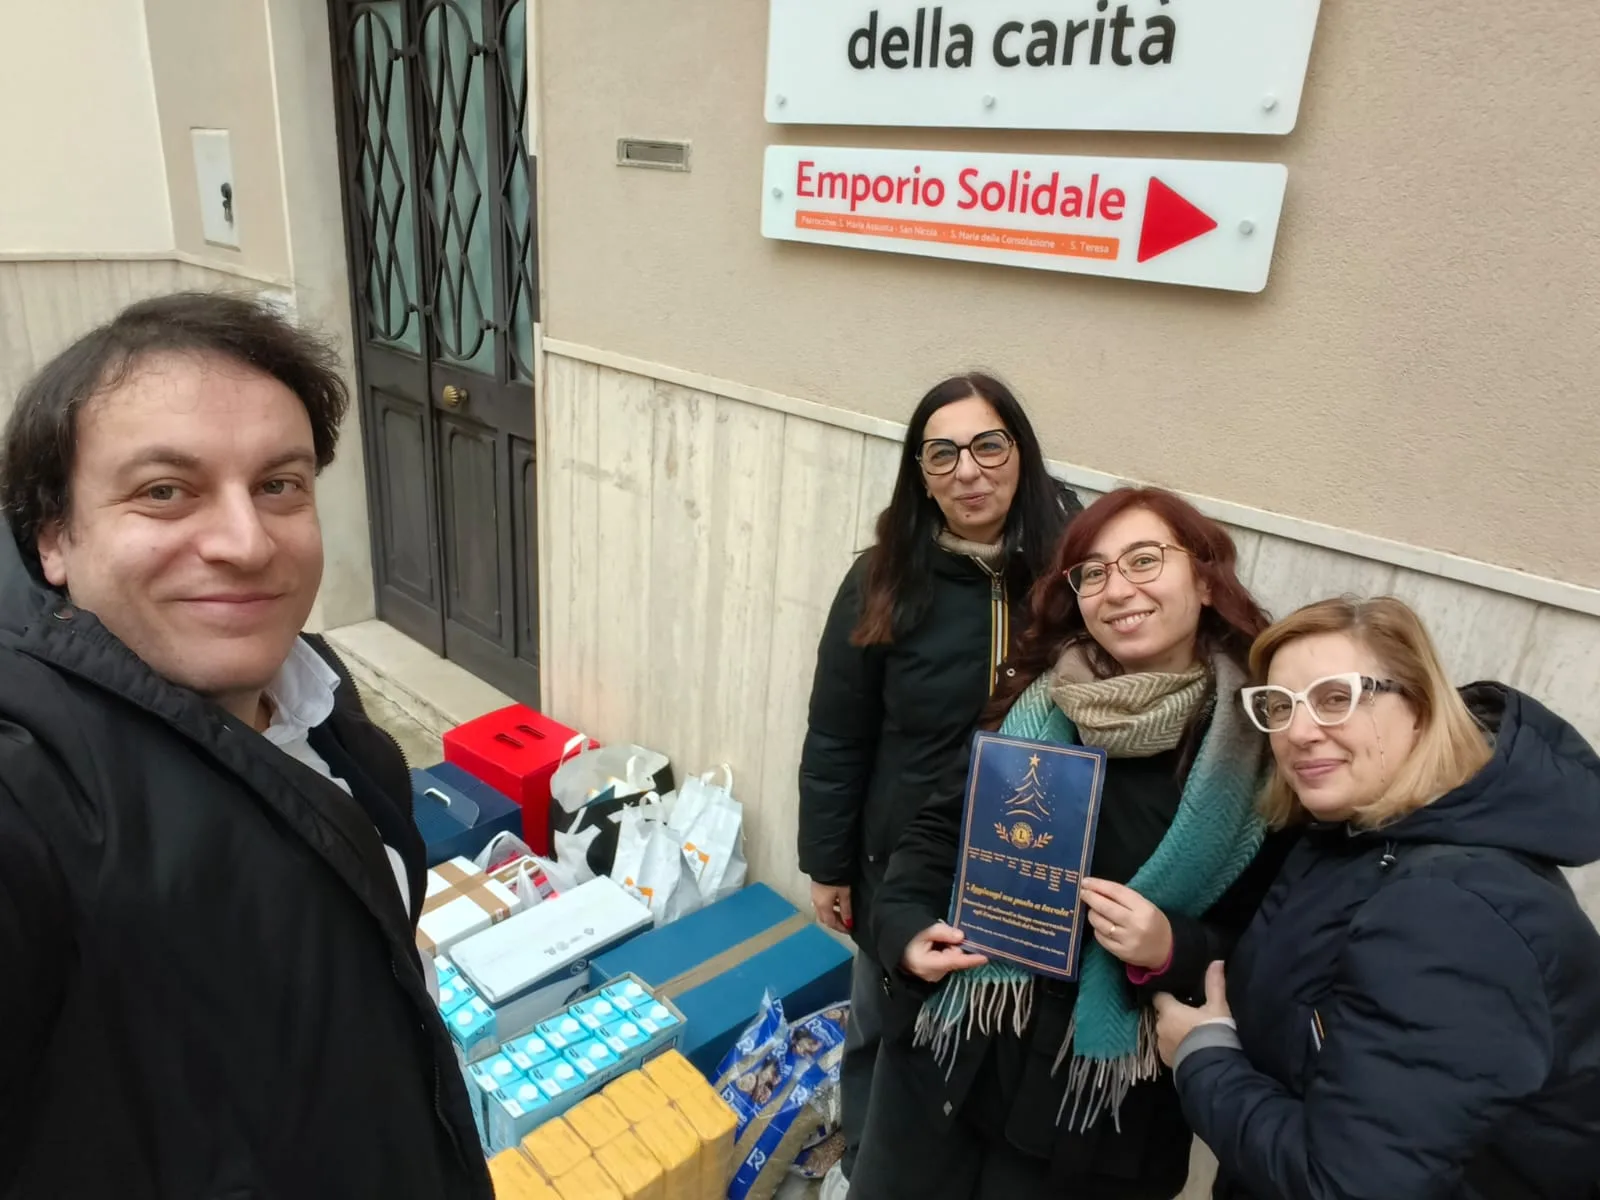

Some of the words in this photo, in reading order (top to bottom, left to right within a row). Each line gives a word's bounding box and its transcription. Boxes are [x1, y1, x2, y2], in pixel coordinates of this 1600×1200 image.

[848, 6, 974, 70] della
[993, 0, 1176, 67] carità
[796, 160, 945, 212] Emporio
[957, 168, 1126, 221] Solidale
[846, 219, 865, 230] Maria
[900, 224, 913, 234] San
[959, 231, 979, 241] Maria
[981, 233, 1000, 244] della
[1001, 234, 1056, 249] Consolazione
[1080, 242, 1109, 254] Teresa
